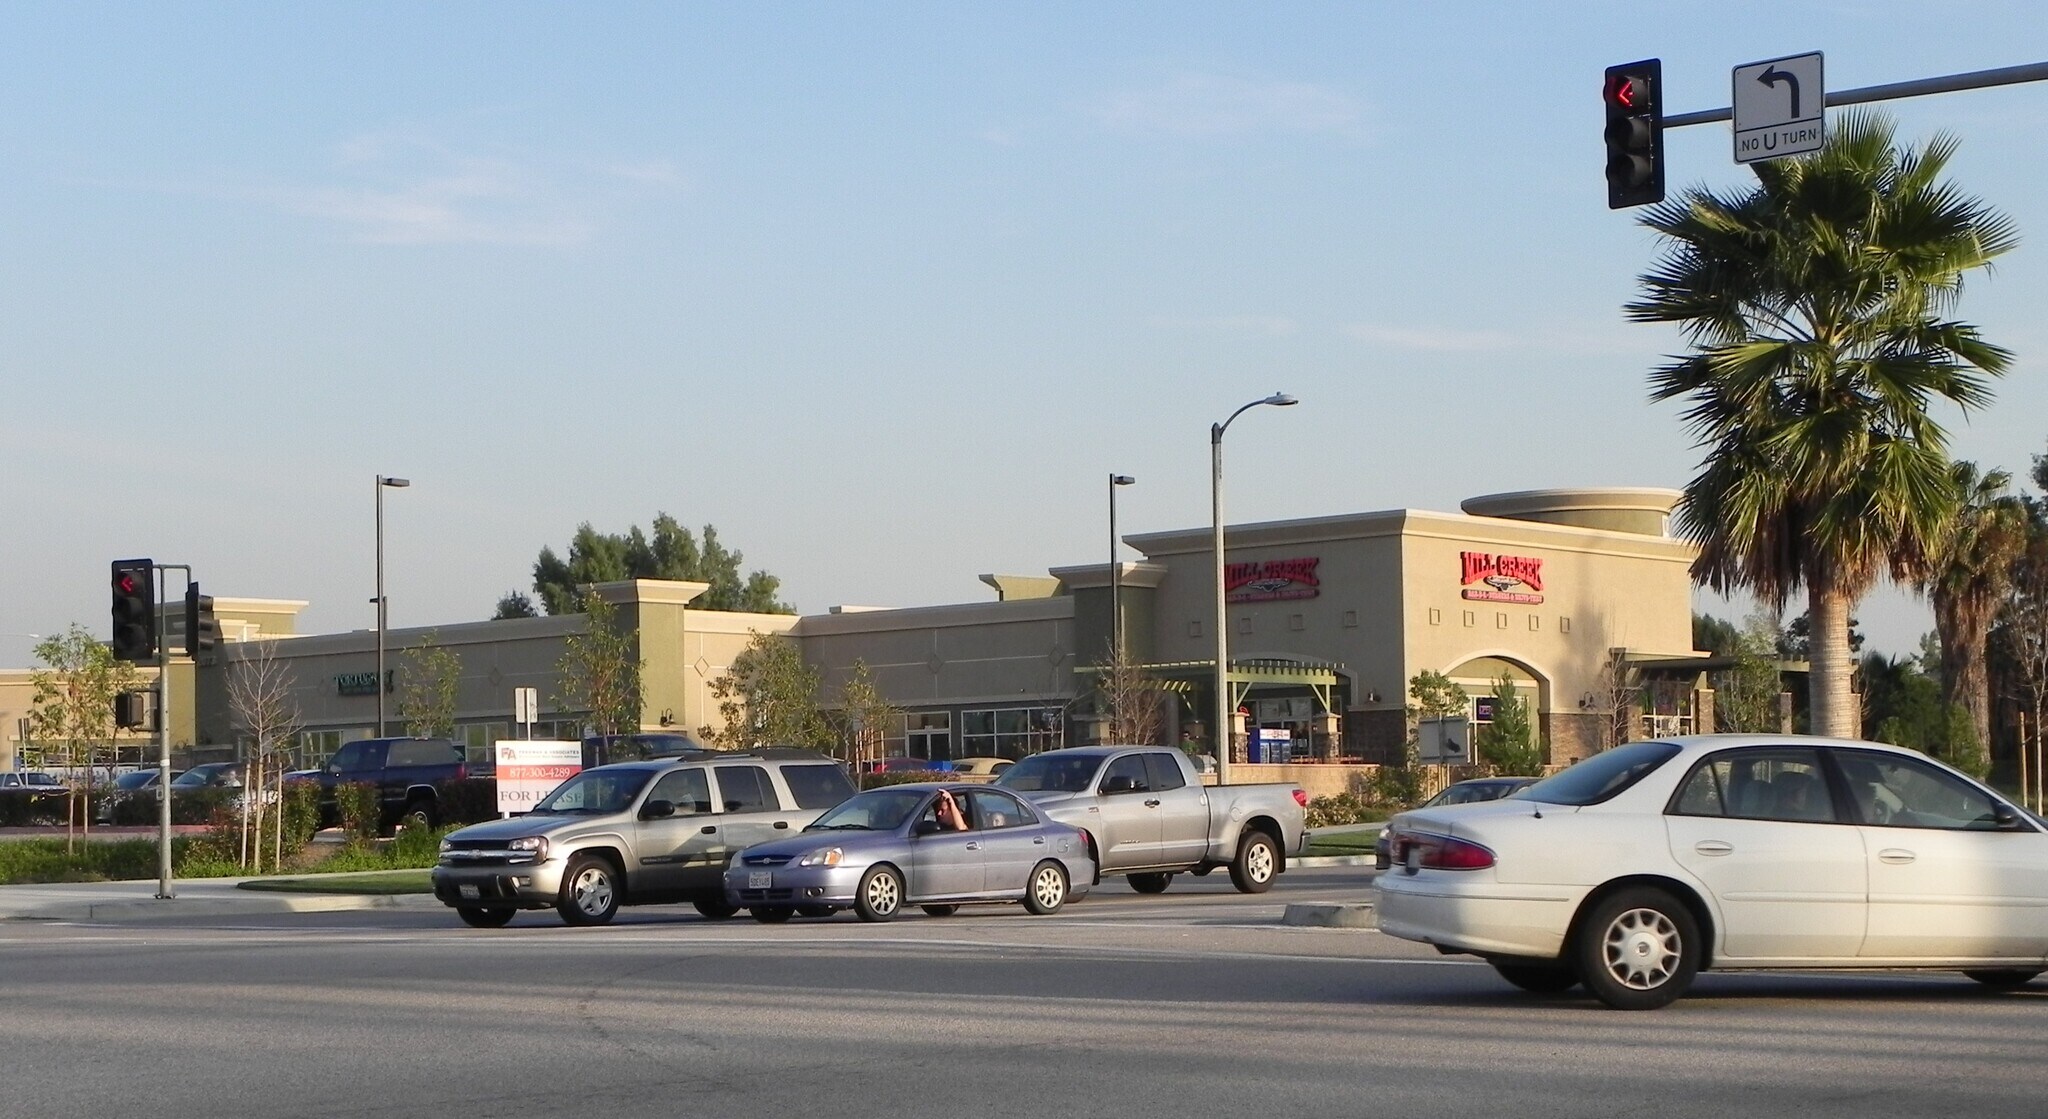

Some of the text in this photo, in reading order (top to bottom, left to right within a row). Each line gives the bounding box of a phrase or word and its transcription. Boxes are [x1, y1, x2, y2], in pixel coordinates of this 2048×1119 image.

[1742, 128, 1817, 152] NO U TURN
[1262, 557, 1320, 587] CREEK
[1460, 551, 1544, 591] MILL CREEK
[510, 768, 571, 777] 877-300-4289
[501, 791, 531, 801] FOR
